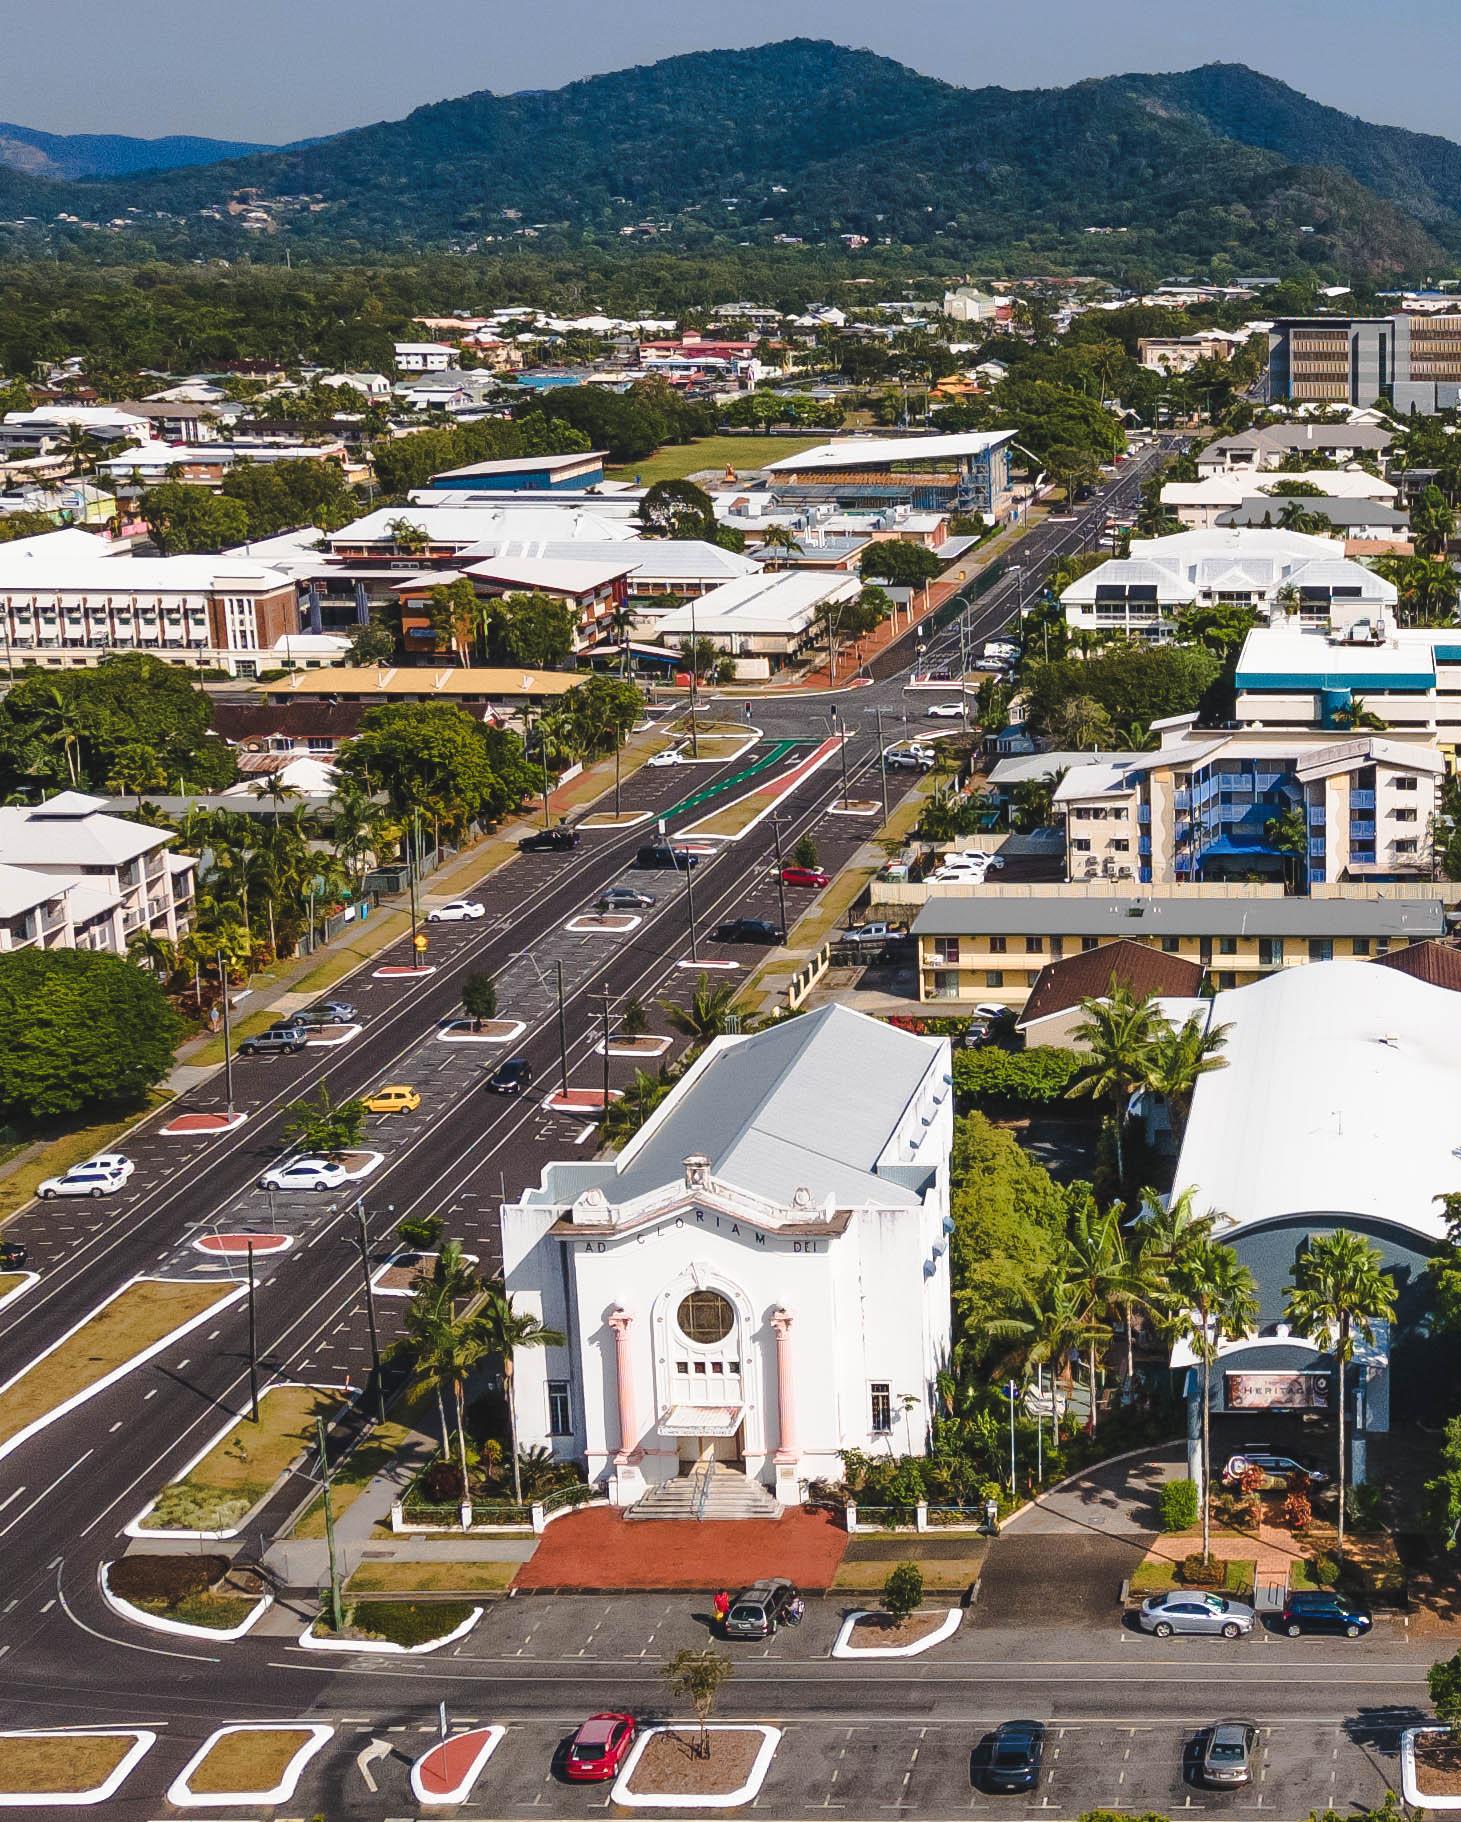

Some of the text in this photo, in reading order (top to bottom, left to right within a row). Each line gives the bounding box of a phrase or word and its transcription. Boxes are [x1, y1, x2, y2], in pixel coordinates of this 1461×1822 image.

[585, 1242, 606, 1253] AD
[794, 1241, 816, 1253] DEI
[1243, 1386, 1312, 1395] HERITAG
